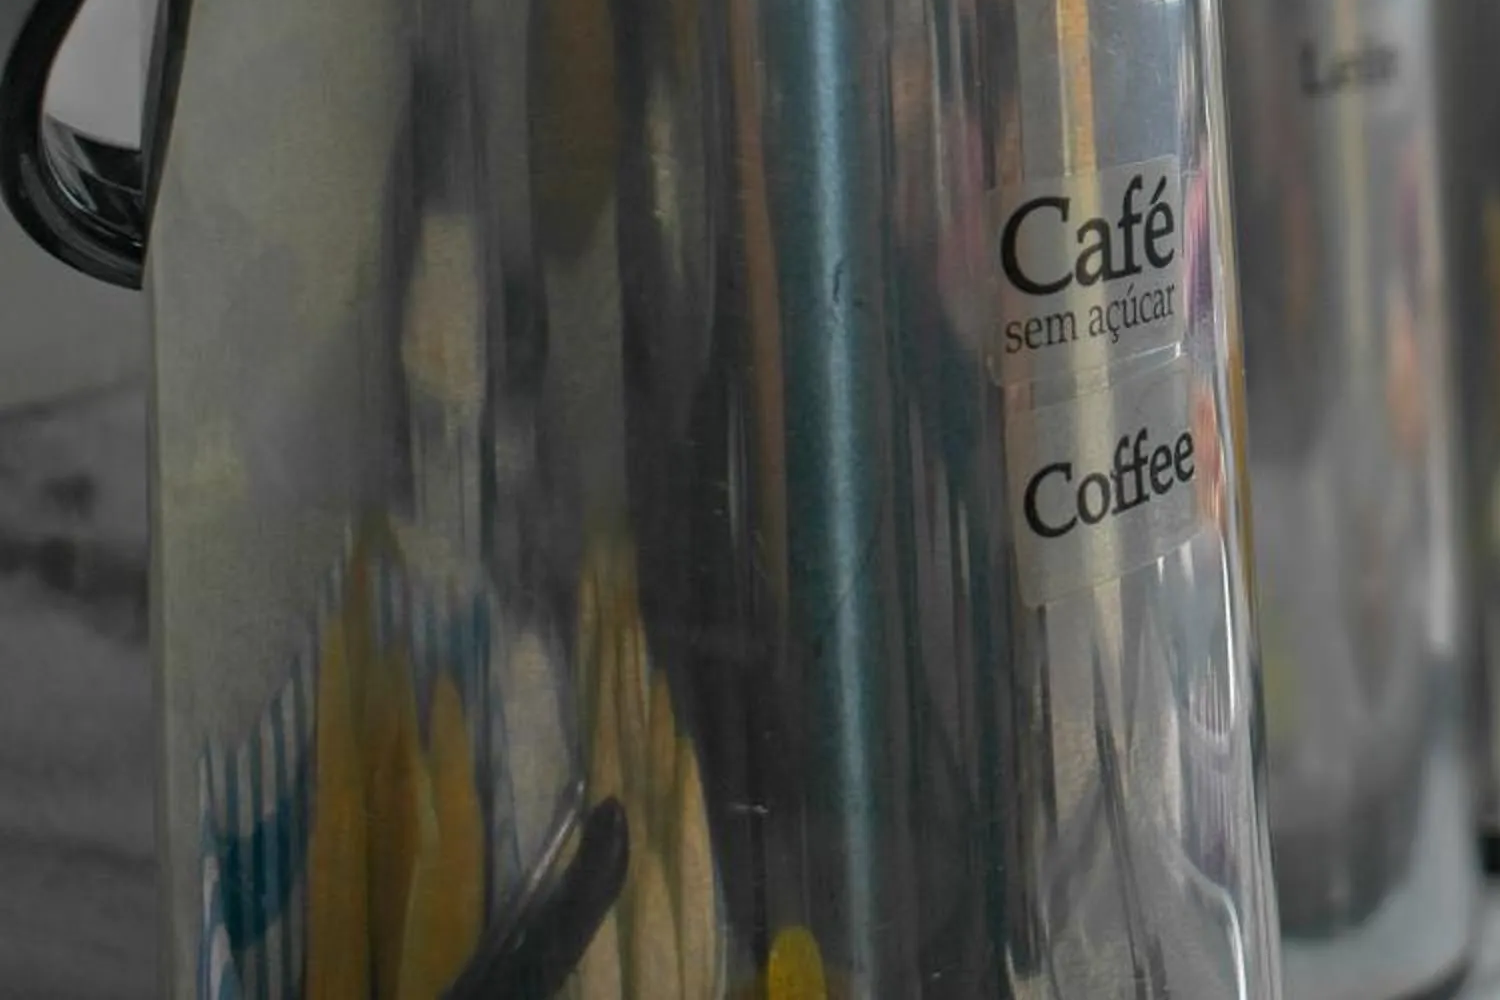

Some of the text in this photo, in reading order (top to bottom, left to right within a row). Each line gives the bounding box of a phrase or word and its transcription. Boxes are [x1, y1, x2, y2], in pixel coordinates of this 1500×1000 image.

[1000, 175, 1175, 297] Café
[1004, 283, 1175, 355] sem açúcar
[1023, 427, 1195, 539] Coffee
